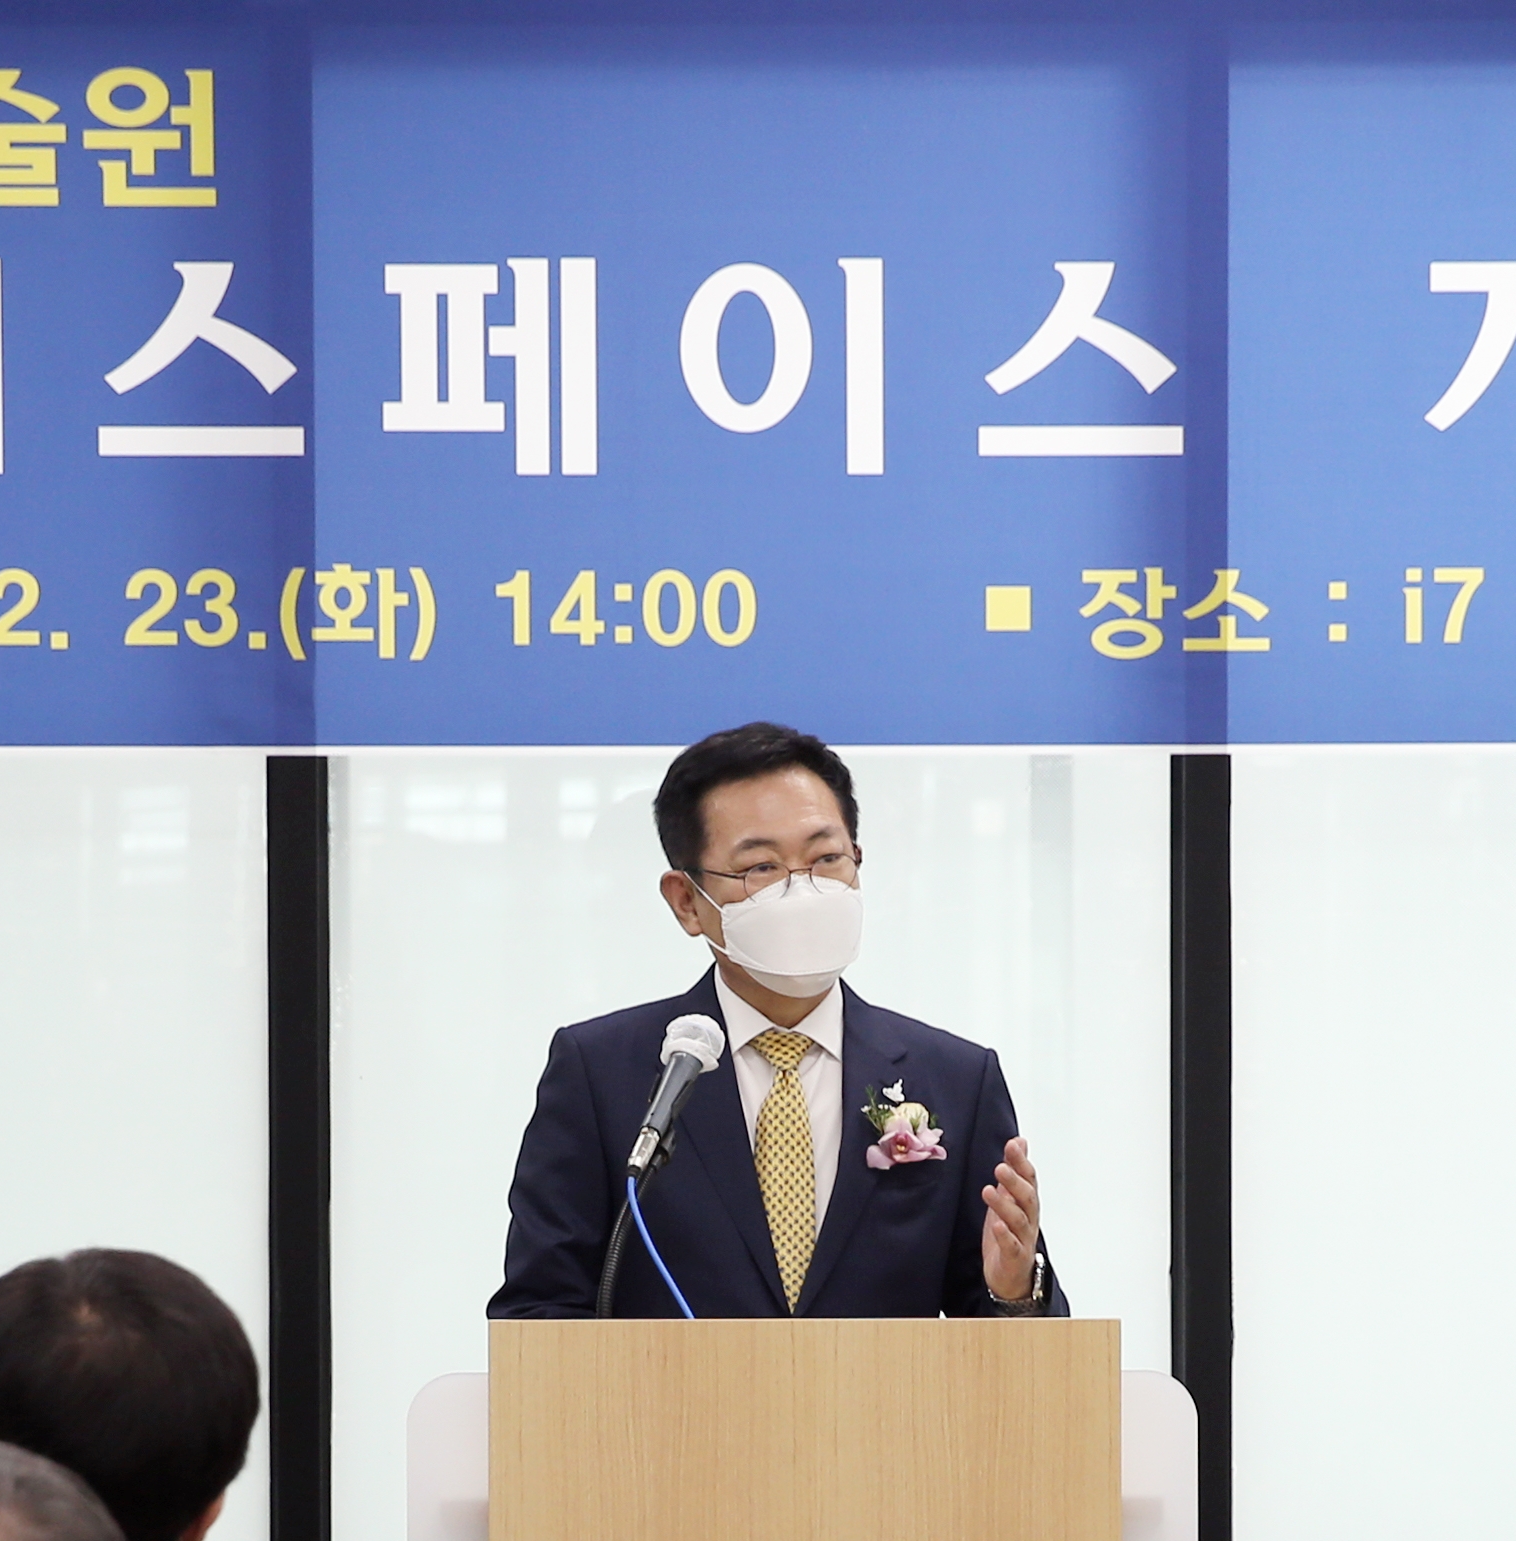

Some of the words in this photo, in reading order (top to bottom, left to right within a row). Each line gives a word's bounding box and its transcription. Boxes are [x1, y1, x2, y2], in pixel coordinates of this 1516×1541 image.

[124, 562, 438, 662] 23.(화)
[495, 567, 758, 648] 14:00
[1079, 565, 1272, 661] 장소
[1403, 566, 1486, 644] i7
